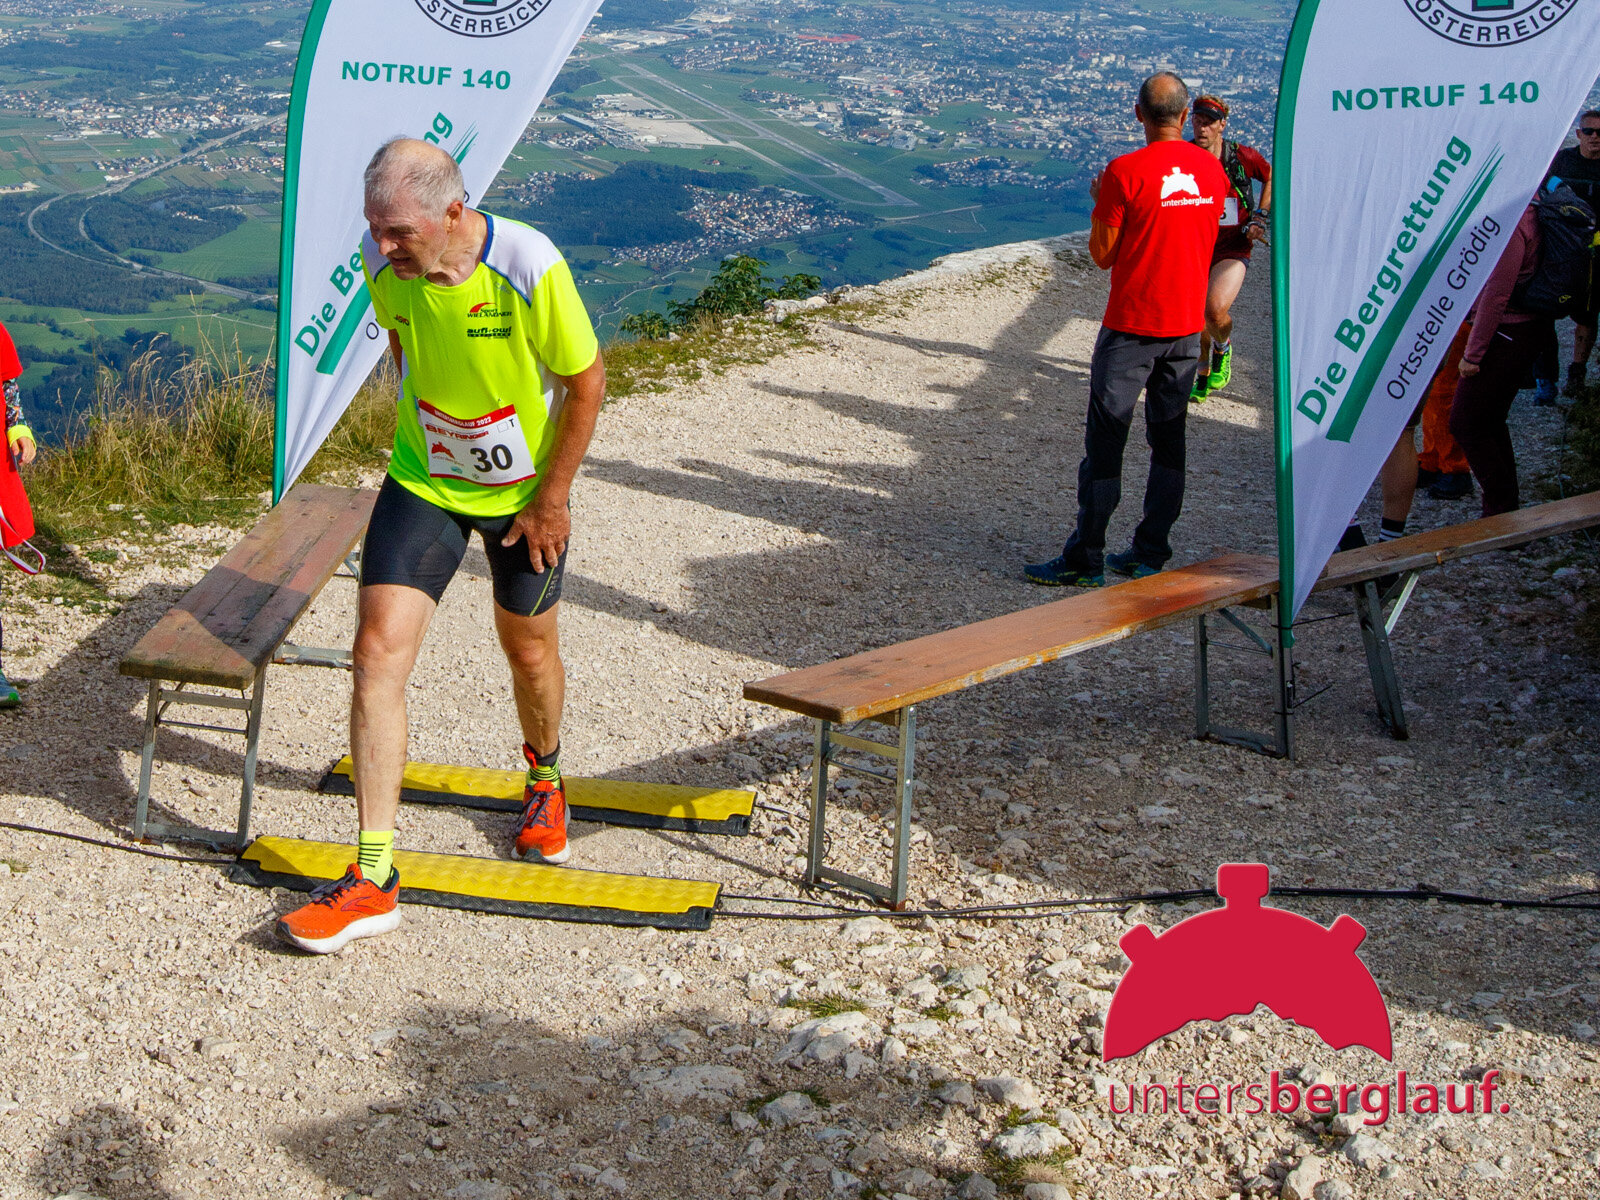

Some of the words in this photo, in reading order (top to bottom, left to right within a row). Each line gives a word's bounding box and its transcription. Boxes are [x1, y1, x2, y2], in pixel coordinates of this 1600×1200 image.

[341, 61, 452, 86] NOTRUF
[462, 68, 511, 91] 140
[1331, 84, 1465, 111] NOTRUF
[1479, 80, 1539, 104] 140
[1296, 361, 1347, 425] Die
[1334, 135, 1472, 353] Bergrettung
[1387, 296, 1454, 400] Ortsstelle
[1447, 215, 1501, 291] Grödig
[294, 302, 337, 357] Die
[476, 416, 492, 426] 2022
[470, 443, 513, 473] 30
